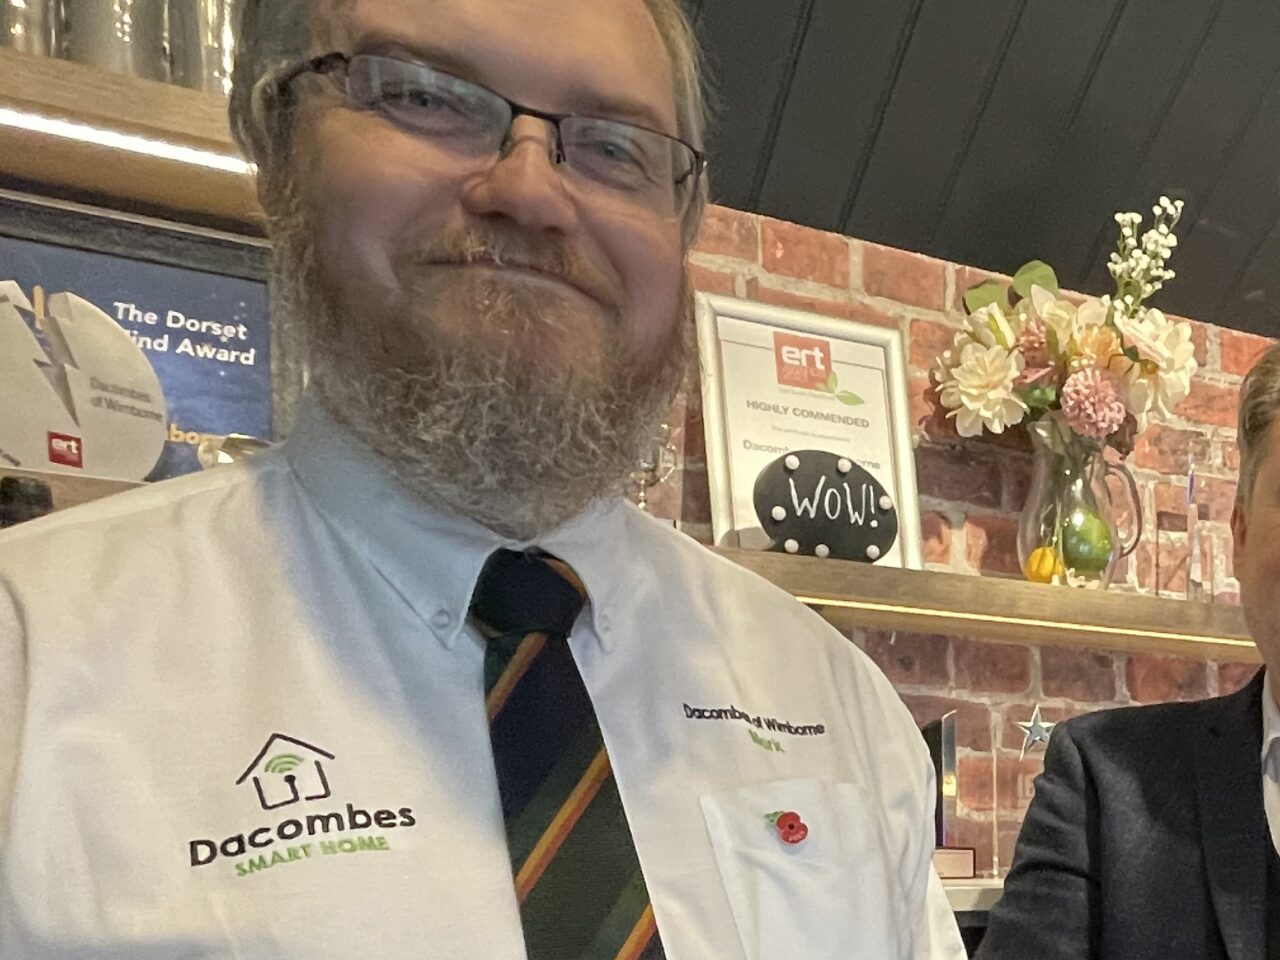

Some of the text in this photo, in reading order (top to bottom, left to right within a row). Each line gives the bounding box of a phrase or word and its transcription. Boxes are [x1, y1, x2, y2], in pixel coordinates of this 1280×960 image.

[113, 301, 249, 341] The Dorset
[126, 330, 256, 367] ind Award
[782, 345, 826, 371] ert
[746, 400, 870, 428] HIGHLY COMMENDED
[743, 439, 791, 455] Dacom
[788, 475, 879, 529] WOW!
[683, 703, 751, 724] Dacombe
[189, 803, 416, 867] Dacombes
[234, 835, 390, 877] SMART HOME
